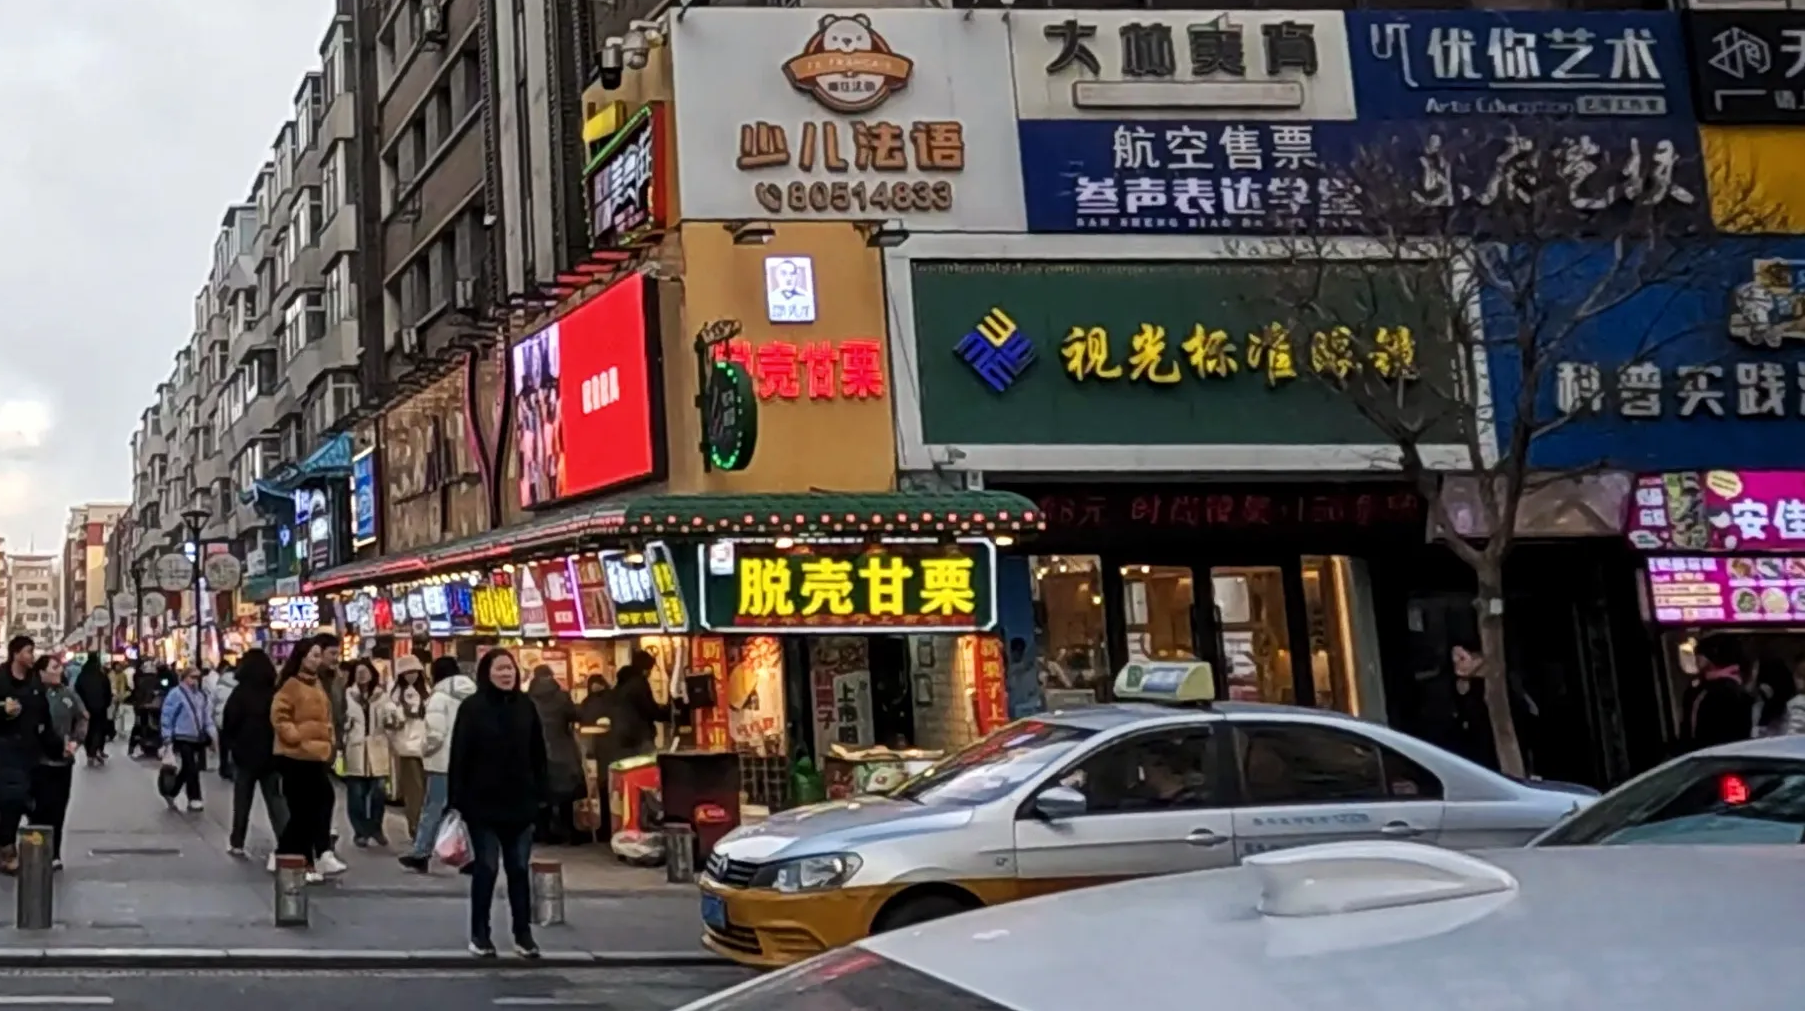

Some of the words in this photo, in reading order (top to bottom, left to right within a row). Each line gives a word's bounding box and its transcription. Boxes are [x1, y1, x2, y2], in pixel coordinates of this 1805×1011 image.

[1427, 27, 1660, 79] 优你艺术
[737, 121, 964, 171] 少儿法语
[1113, 125, 1317, 170] 航空售票
[788, 181, 953, 212] 80514833
[1557, 361, 1805, 417] 科普实践
[738, 556, 975, 616] 脱壳甘栗
